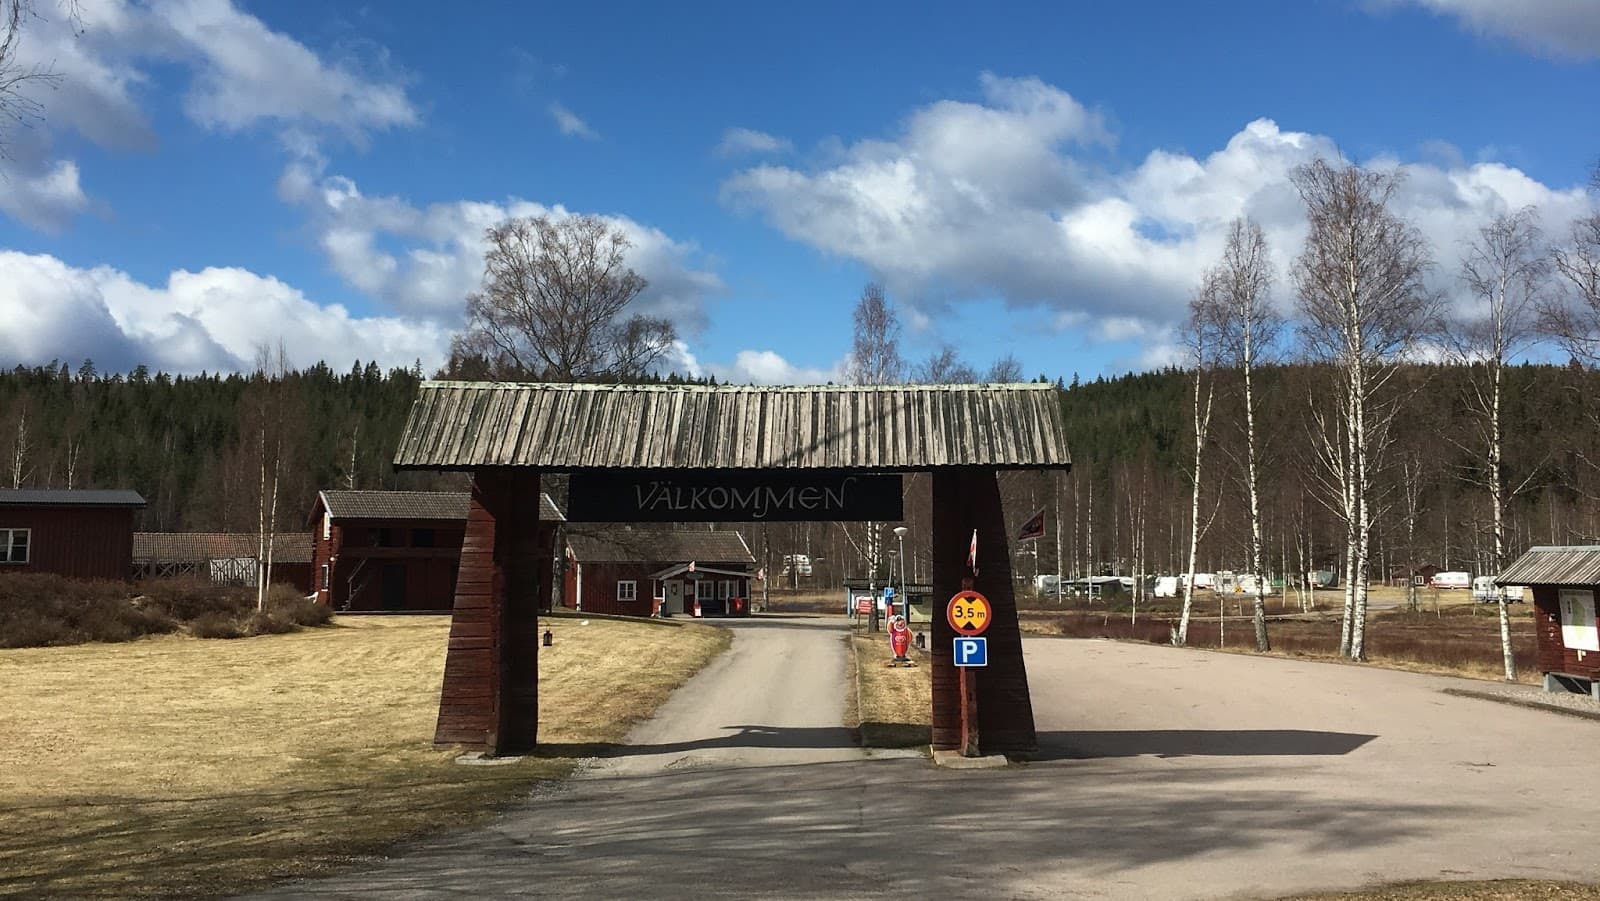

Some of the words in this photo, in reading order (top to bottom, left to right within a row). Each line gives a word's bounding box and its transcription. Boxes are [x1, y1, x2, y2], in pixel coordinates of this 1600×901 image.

[634, 477, 857, 518] VÄLKOMMEN
[955, 606, 974, 619] 3,5
[962, 641, 978, 663] P
